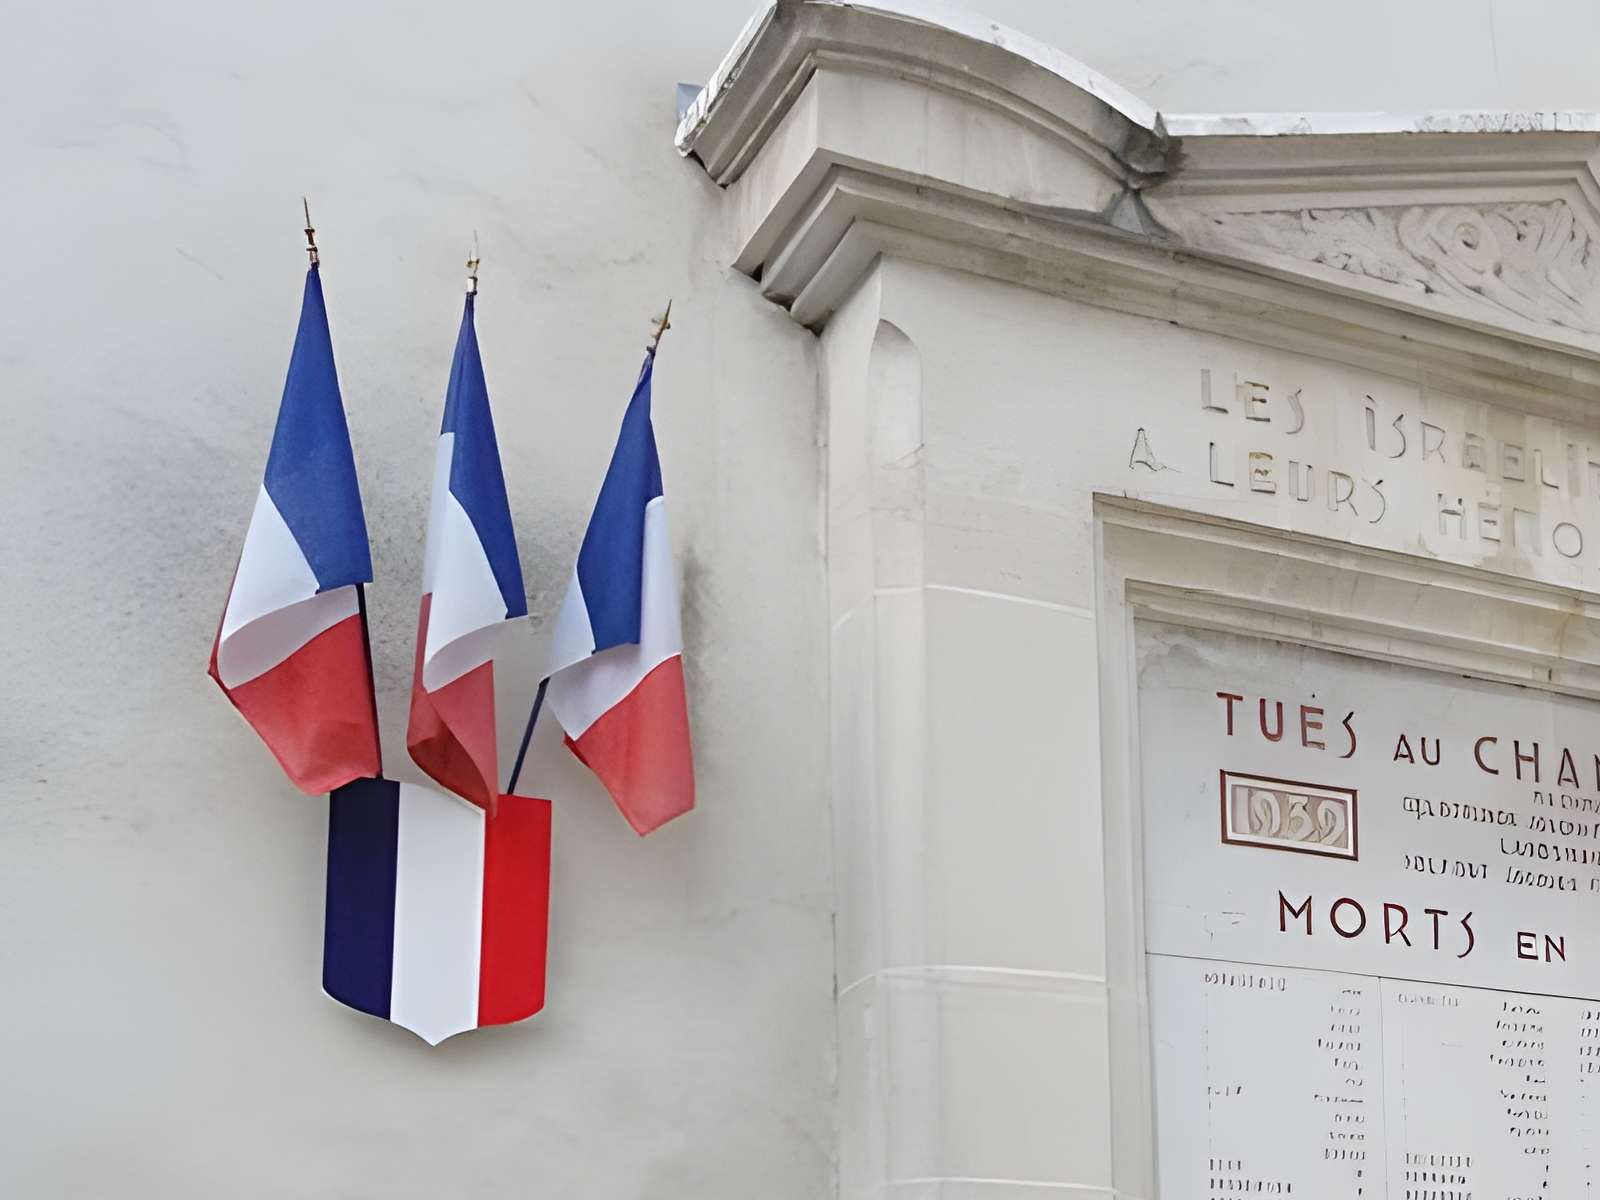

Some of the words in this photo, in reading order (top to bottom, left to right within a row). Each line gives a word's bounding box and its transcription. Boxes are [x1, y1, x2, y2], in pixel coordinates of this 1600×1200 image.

[1199, 368, 1305, 435] LES
[1208, 441, 1386, 524] LEURS
[1393, 733, 1441, 767] AU
[1278, 889, 1475, 959] MORTS
[1516, 931, 1567, 963] EN
